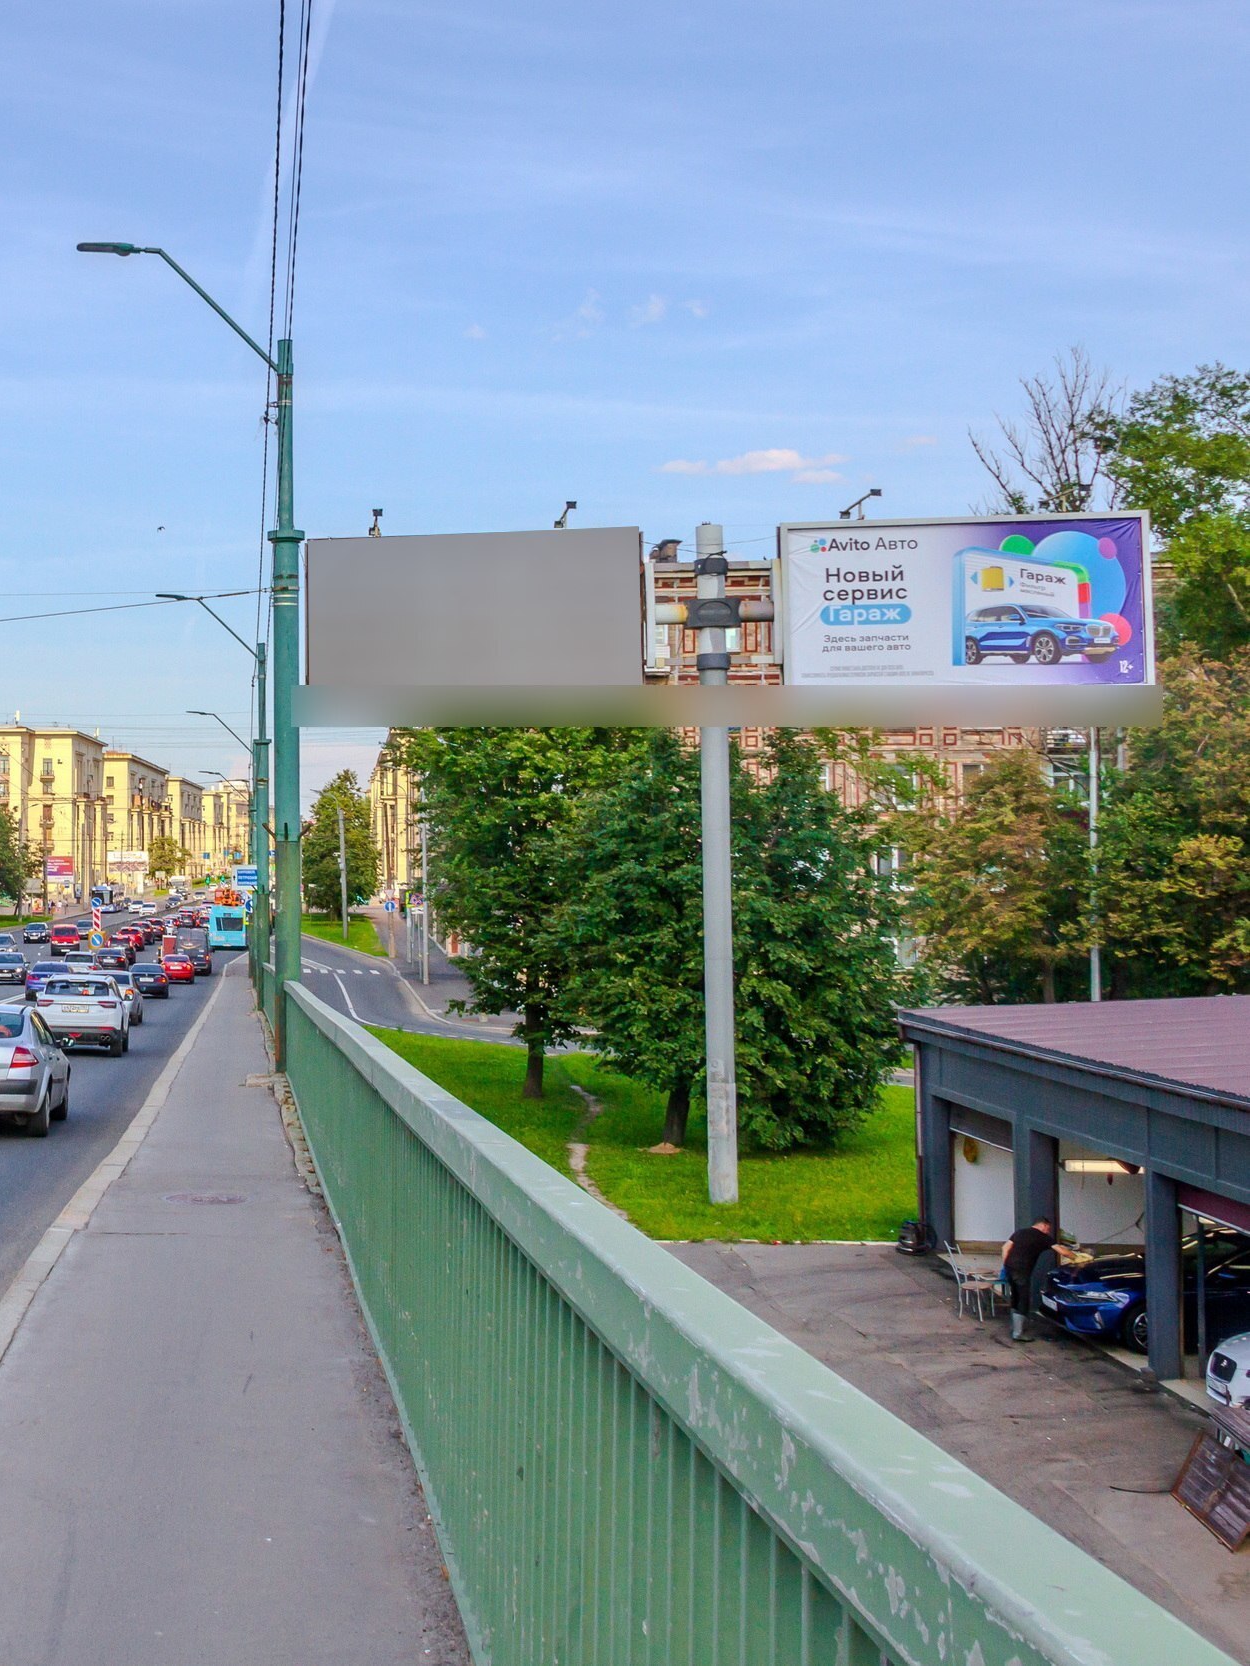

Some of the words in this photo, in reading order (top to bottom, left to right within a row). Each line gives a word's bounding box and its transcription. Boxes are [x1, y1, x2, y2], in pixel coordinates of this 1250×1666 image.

[828, 538, 870, 552] Avito
[875, 537, 918, 551] Авто
[825, 565, 904, 583] Новый
[1019, 568, 1067, 586] Гараж
[823, 588, 908, 606] сервис
[829, 605, 902, 625] Гараж
[824, 635, 857, 643] Здесь
[859, 634, 909, 642] запчасти
[1119, 660, 1134, 674] 12+
